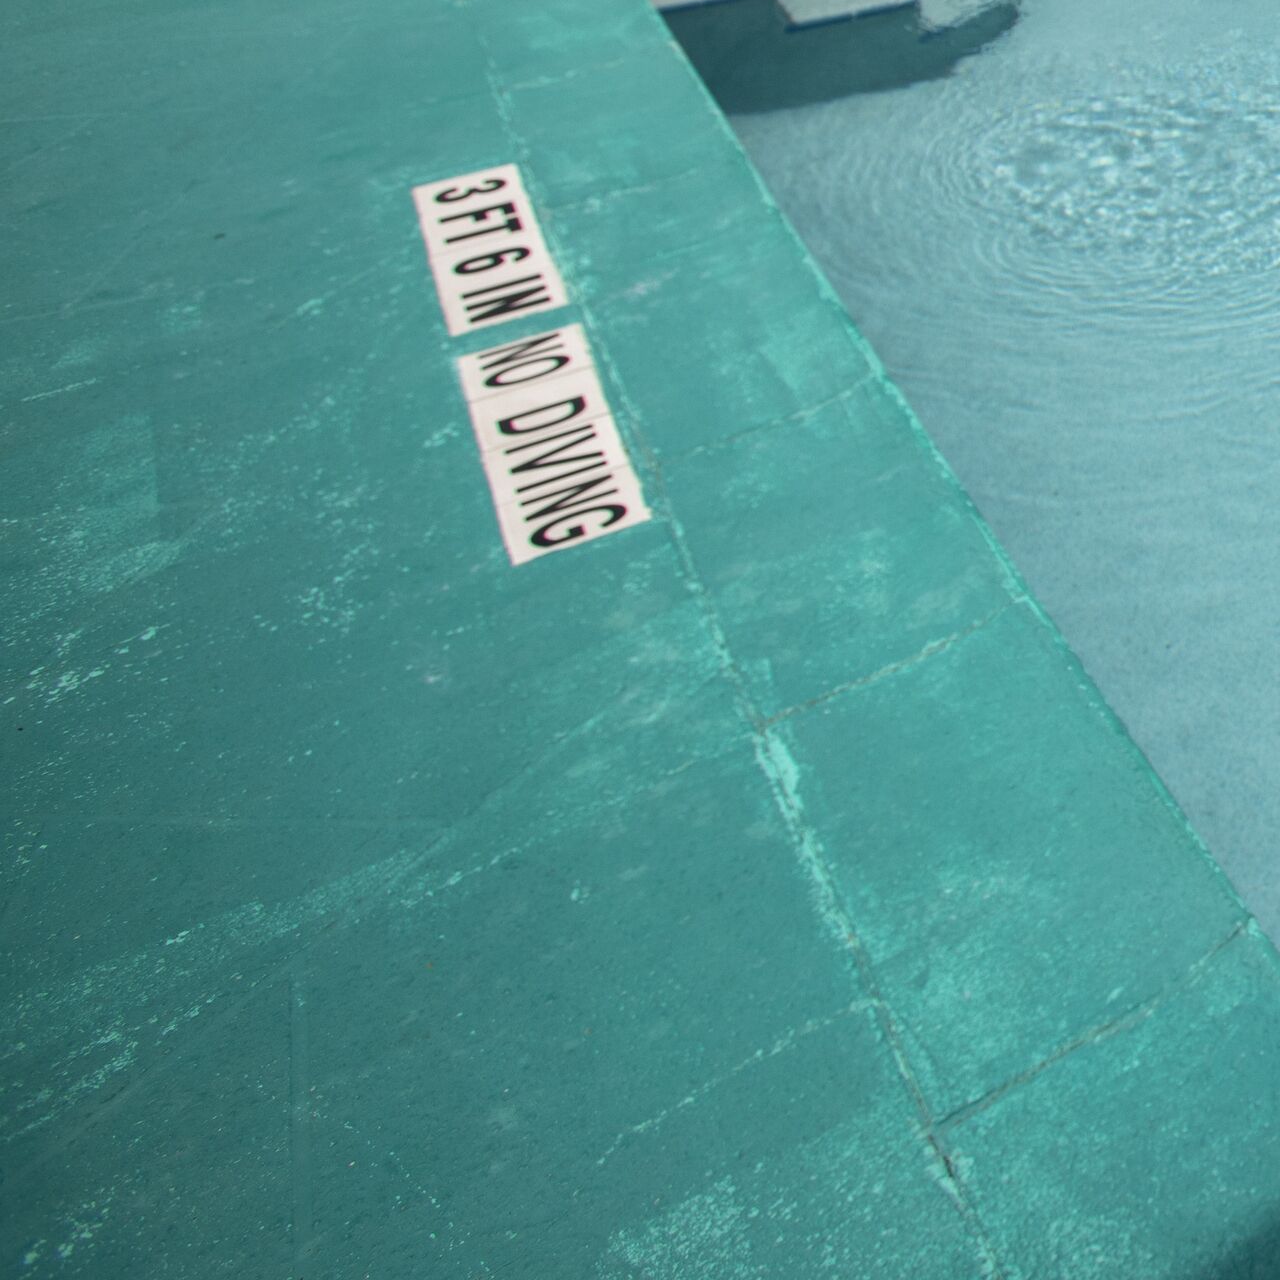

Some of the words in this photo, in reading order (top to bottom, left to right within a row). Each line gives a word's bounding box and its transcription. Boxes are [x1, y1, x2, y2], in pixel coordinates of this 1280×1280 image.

[434, 178, 507, 204] 3
[438, 201, 524, 244] FT
[453, 246, 531, 275] 6
[462, 273, 551, 324] IN
[477, 333, 570, 388] NO
[496, 396, 628, 548] DIVING
